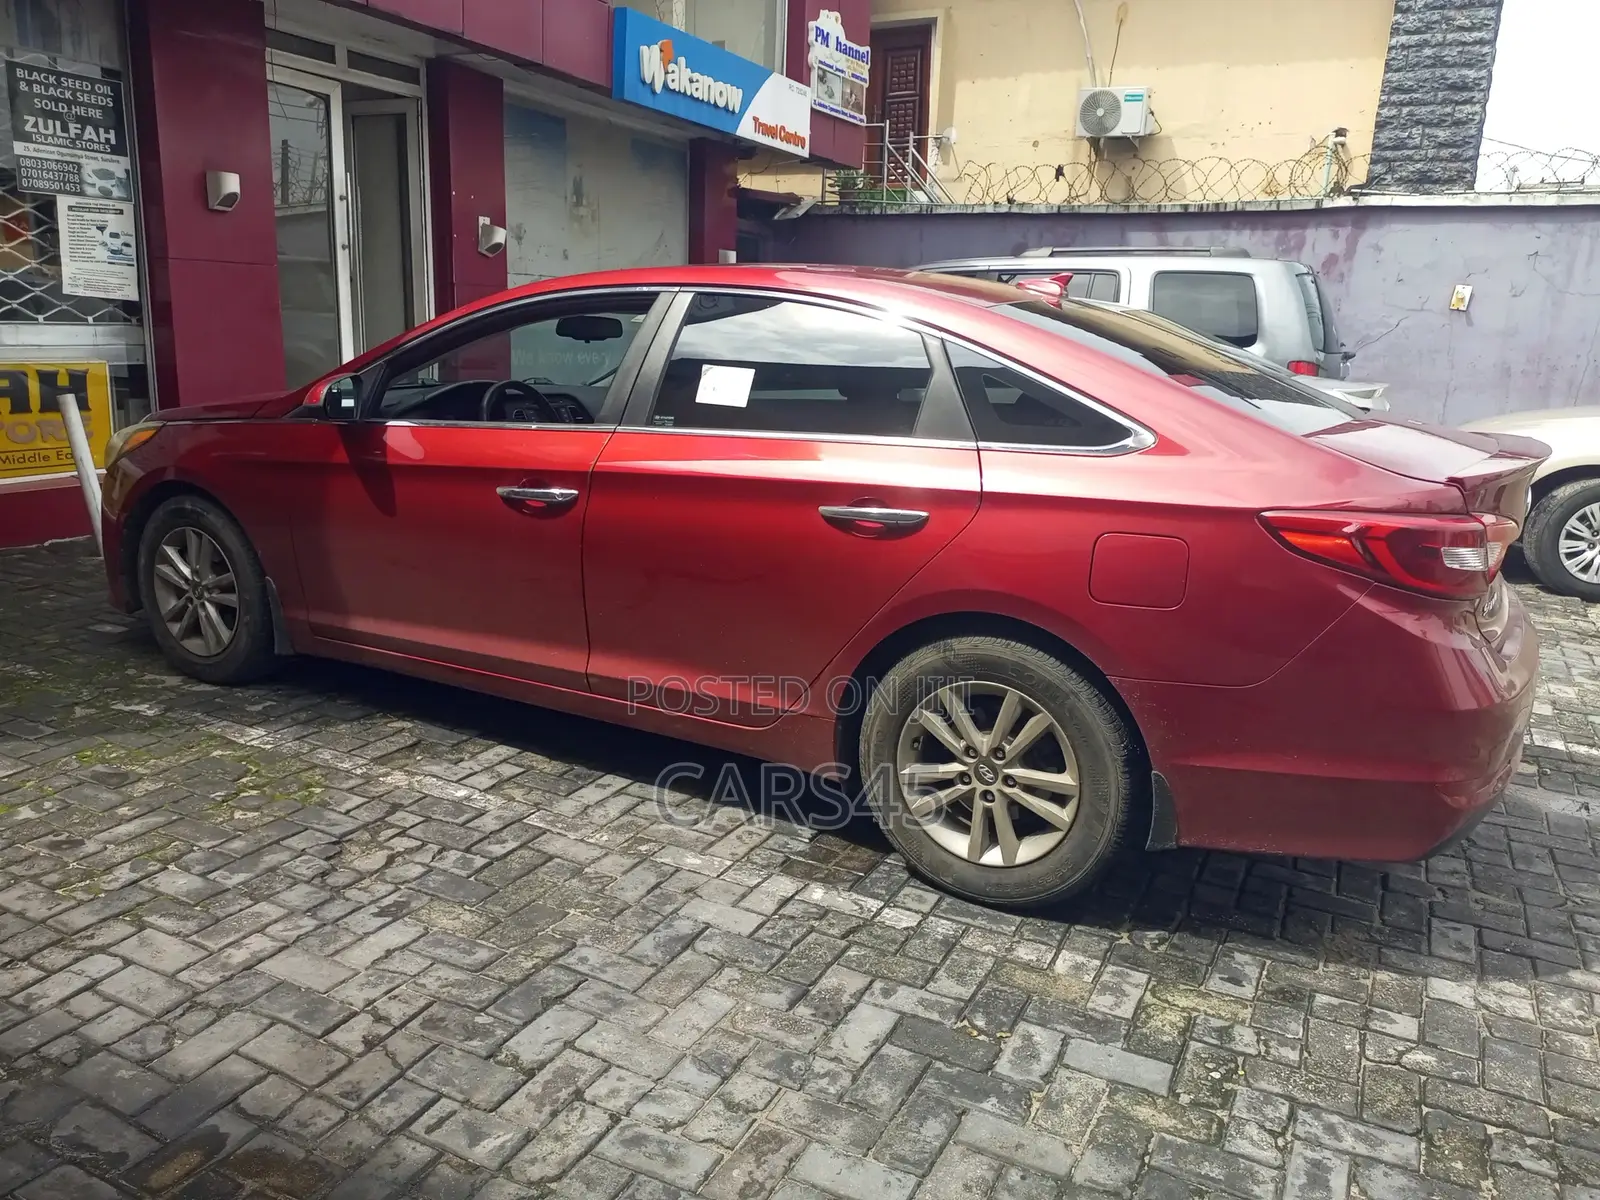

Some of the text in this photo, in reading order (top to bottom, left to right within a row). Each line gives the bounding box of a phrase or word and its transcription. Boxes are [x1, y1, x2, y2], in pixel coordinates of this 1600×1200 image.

[814, 25, 830, 48] PM
[16, 68, 114, 96] BLACK SEED OIL
[639, 39, 744, 114] Wakanow
[19, 81, 114, 107] & BLACK SEEDS
[34, 98, 103, 119] SOLD HERE
[63, 110, 76, 123] @
[23, 115, 116, 145] ZULFAH
[752, 116, 807, 150] Travel Centre
[32, 133, 111, 153] ISLAMIC STORES
[20, 157, 79, 174] 08033066942
[21, 168, 80, 183] 07016437788
[22, 179, 81, 193] 07089501453
[0, 450, 74, 465] Middle Ea
